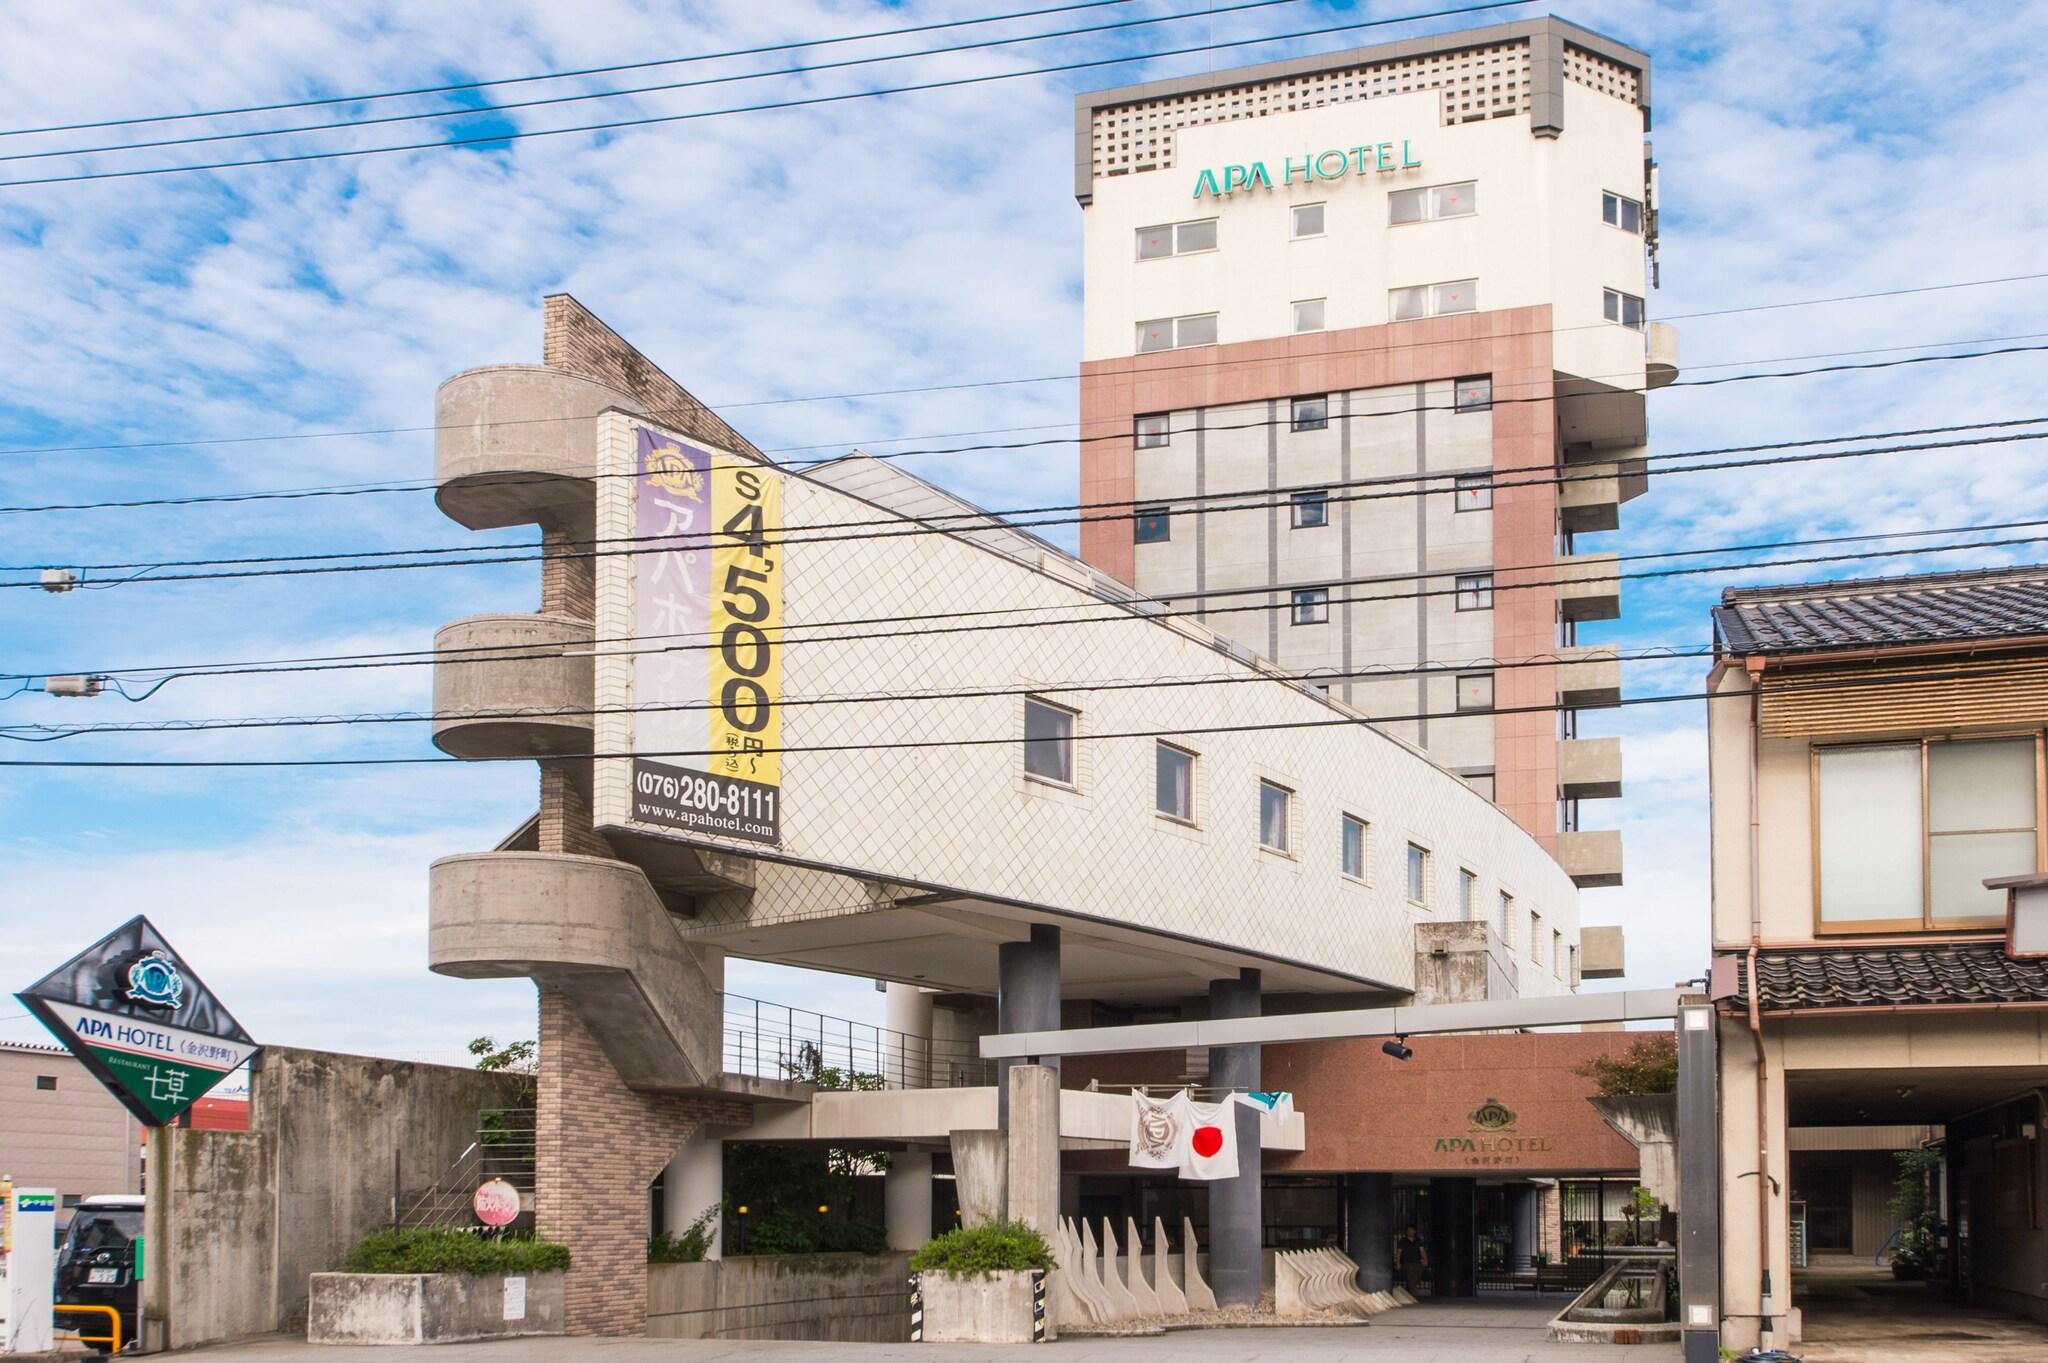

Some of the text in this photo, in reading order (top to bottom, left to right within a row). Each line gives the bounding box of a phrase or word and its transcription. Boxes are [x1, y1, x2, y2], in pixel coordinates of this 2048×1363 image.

[1192, 139, 1423, 199] APA HOTEL
[638, 803, 774, 836] www.apahotel.com
[76, 1017, 112, 1039] APA
[117, 1025, 174, 1052] HOTEL
[108, 1056, 151, 1071] RESTAURANT
[1434, 1136, 1553, 1152] APA HOTEL
